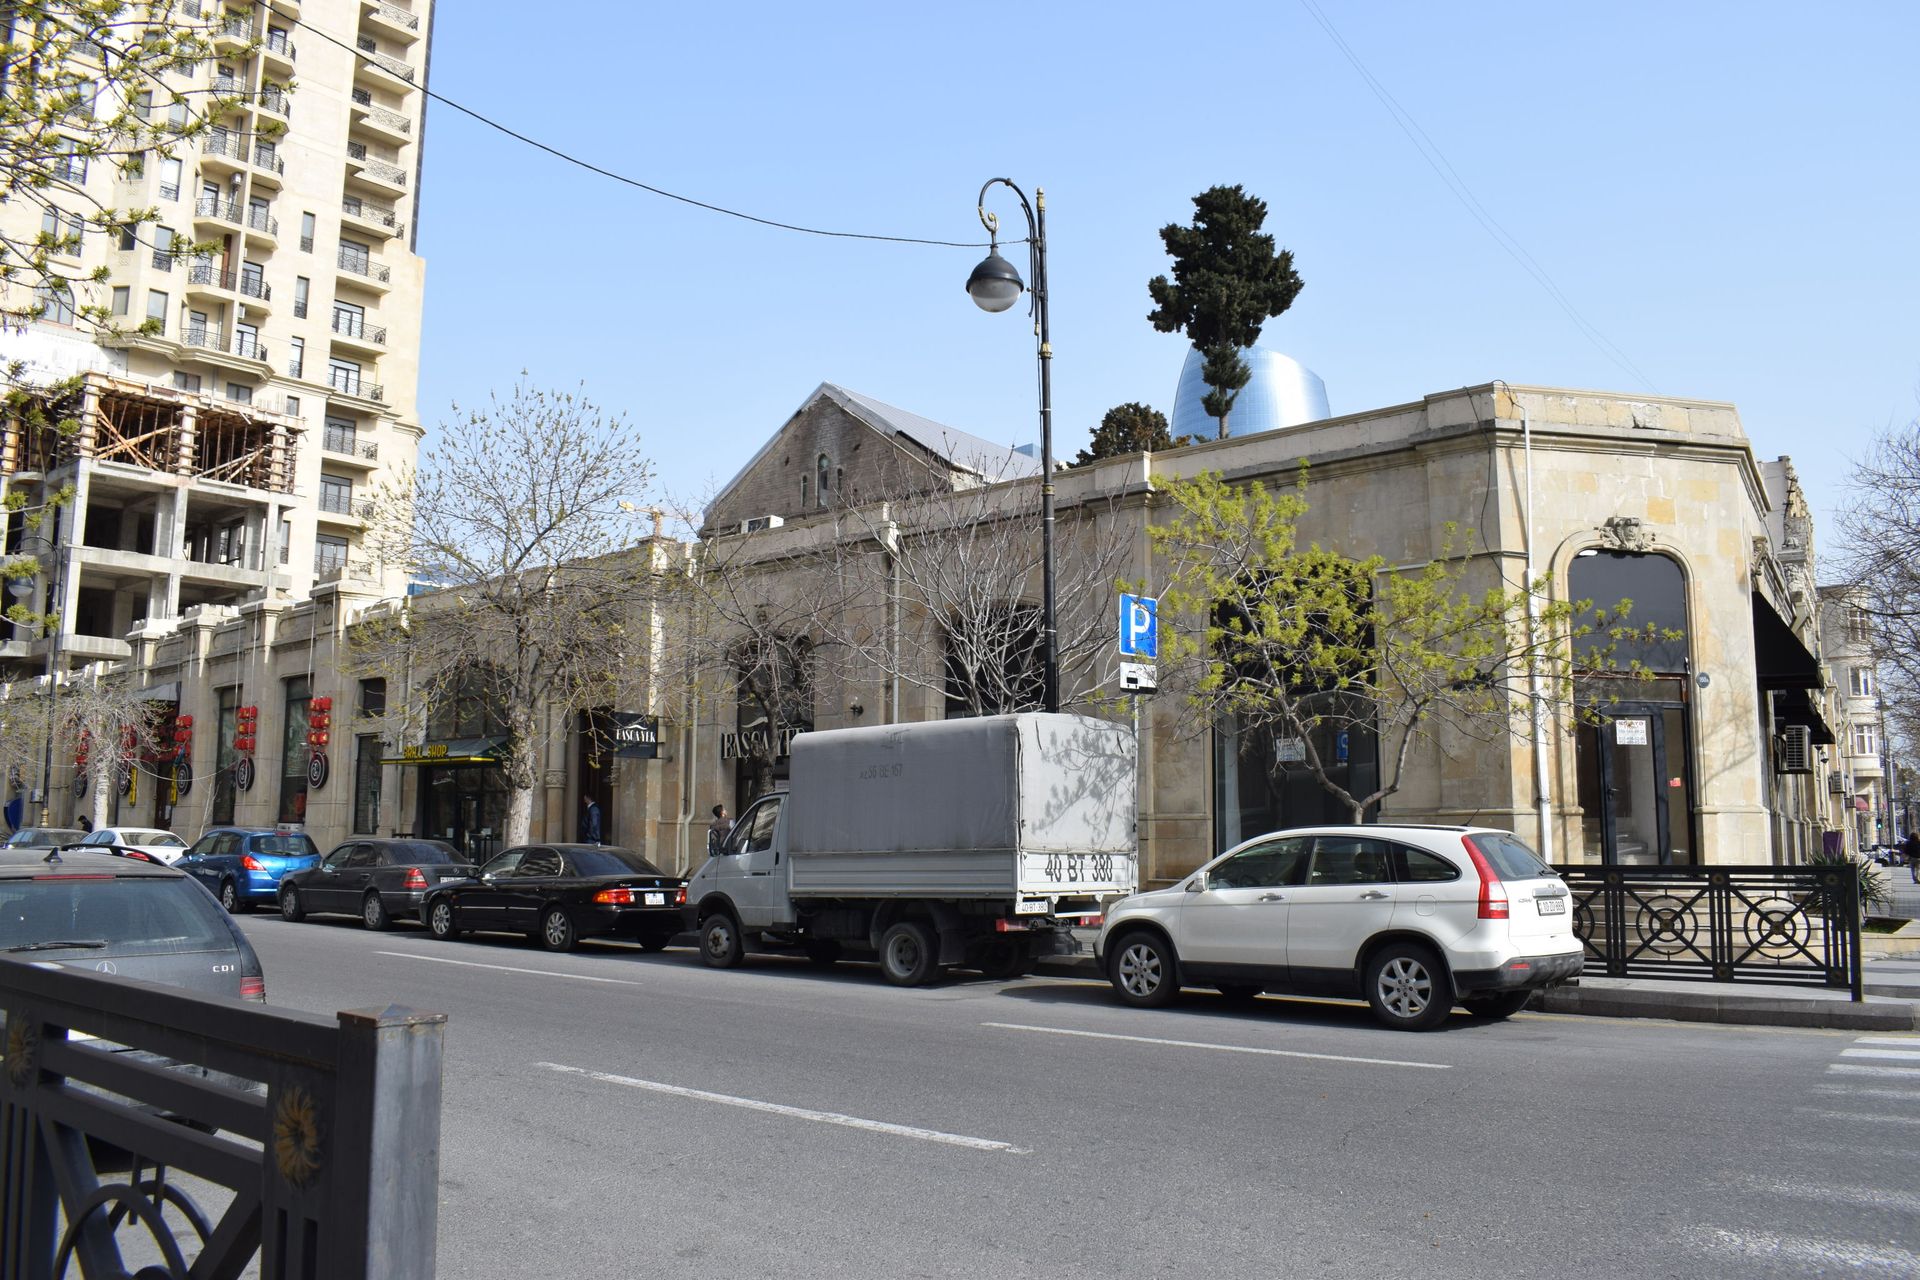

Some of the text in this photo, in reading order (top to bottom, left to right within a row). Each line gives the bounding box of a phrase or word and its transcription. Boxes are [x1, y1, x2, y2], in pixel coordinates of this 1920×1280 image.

[1130, 602, 1150, 648] P
[427, 743, 449, 758] SHOP
[1044, 853, 1113, 882] 40 BT 380
[212, 964, 234, 973] CDI
